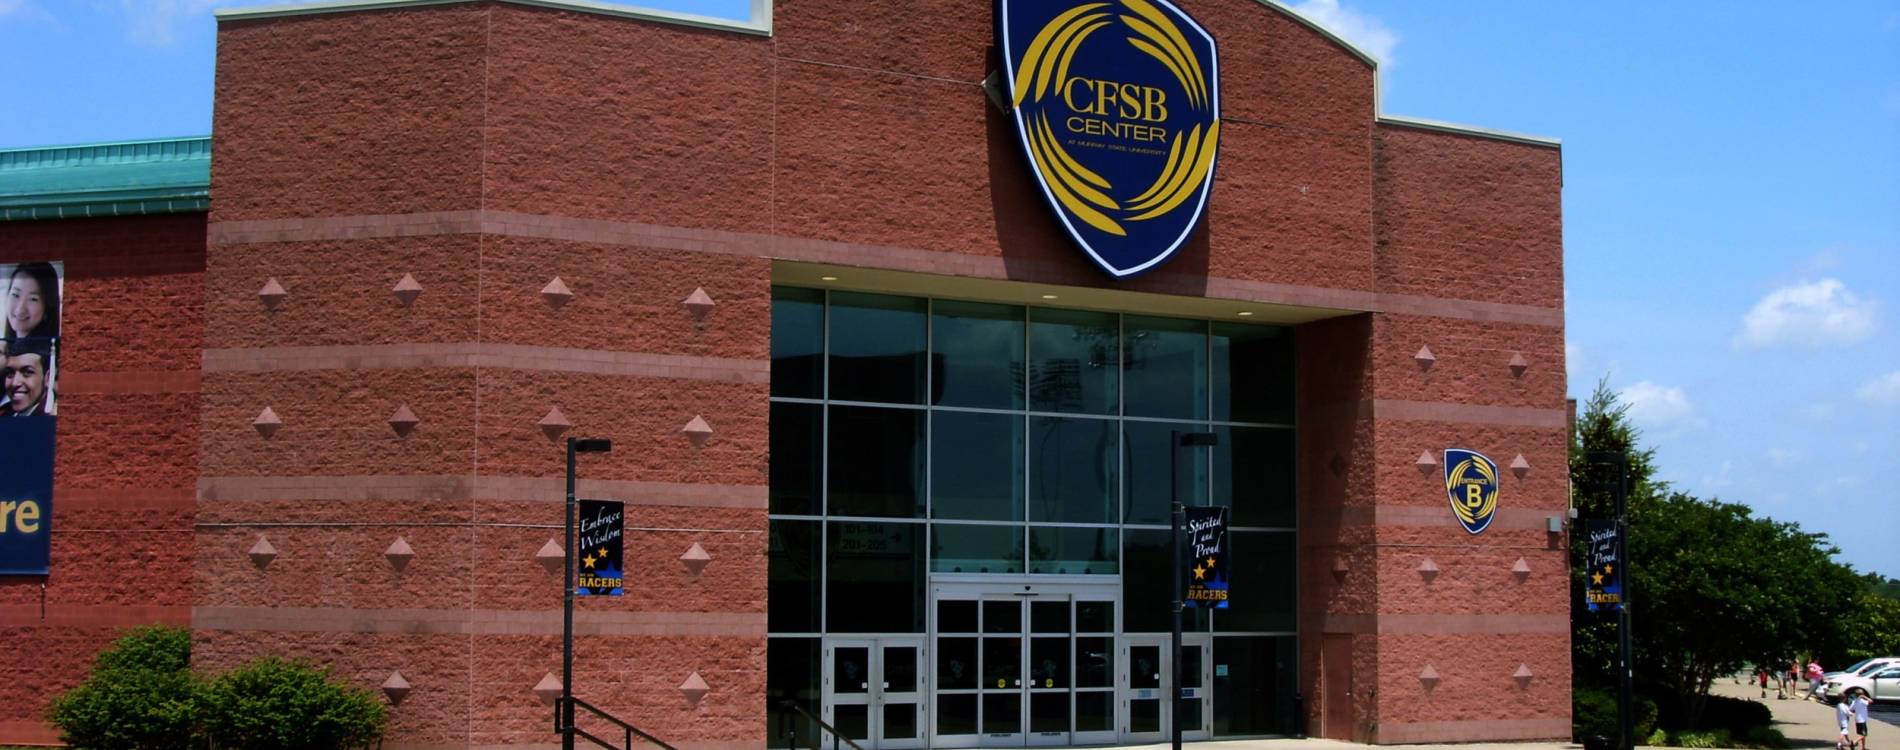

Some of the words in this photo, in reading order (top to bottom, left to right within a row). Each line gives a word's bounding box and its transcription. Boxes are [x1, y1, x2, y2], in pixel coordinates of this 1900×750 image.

[1064, 77, 1168, 122] CFSB
[1066, 116, 1166, 143] CENTER
[1467, 484, 1482, 508] B
[581, 506, 620, 532] Embrace
[1189, 506, 1225, 545] Spirited
[581, 524, 620, 550] Wisdom
[1195, 531, 1224, 558] Proud
[1201, 528, 1213, 541] and
[1589, 520, 1617, 554] Spirited
[1594, 542, 1618, 565] Proud
[579, 577, 622, 588] RACERS
[1188, 589, 1228, 600] RACERS
